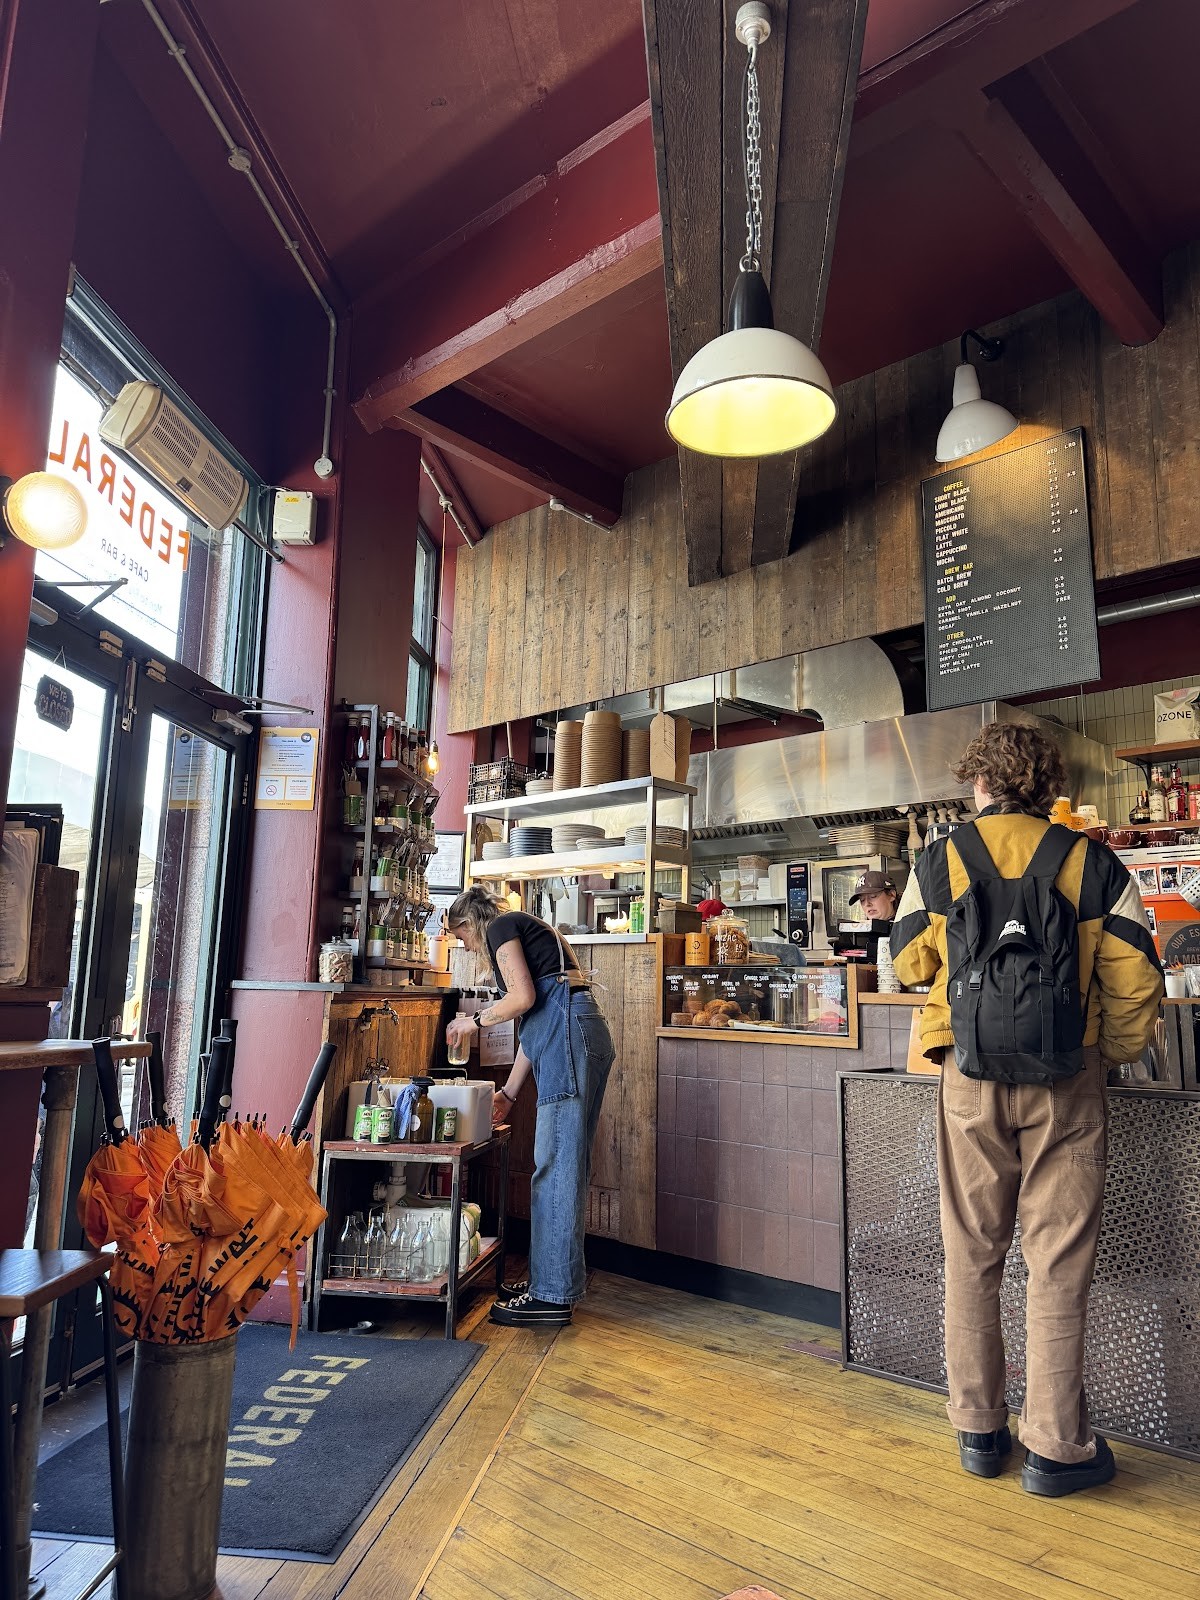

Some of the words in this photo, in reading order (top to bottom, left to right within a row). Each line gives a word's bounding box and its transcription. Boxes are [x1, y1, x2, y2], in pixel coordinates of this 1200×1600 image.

[943, 480, 964, 492] COFFEE
[934, 492, 951, 503] SHORT
[953, 486, 970, 497] BLACK
[935, 501, 949, 511] LONG
[950, 496, 967, 506] BLACK
[935, 505, 965, 519] AMERICANO
[935, 512, 965, 527] MACCHIATO
[935, 523, 957, 535] PICCOLO
[935, 533, 949, 542] FLAT
[951, 527, 968, 538] WHITE
[936, 540, 953, 551] LATTE
[936, 544, 968, 558] CAPPUCCINO
[936, 556, 955, 566] MOCHA
[944, 565, 960, 576] BREW
[963, 562, 974, 571] BAR
[937, 576, 954, 586] BATCH
[956, 571, 972, 580] BREW
[937, 584, 951, 594] COLD
[953, 580, 969, 590] BREW
[938, 604, 952, 612] SOYA
[970, 594, 992, 603] ALMOND
[995, 586, 1021, 597] COCONUT
[945, 594, 957, 603] ADD
[938, 610, 955, 618] EXTRA
[957, 605, 972, 613] SHOT
[938, 615, 962, 624] CARAMEL
[966, 608, 989, 618] VANILLA
[993, 600, 1022, 611] HAZELNUT
[938, 623, 955, 631] DECAF
[1056, 595, 1071, 603] FREE
[946, 631, 965, 641] OTHER
[952, 635, 983, 646] CHOCOLATE
[975, 640, 994, 648] LATTE
[939, 667, 961, 675] MATCHA
[963, 663, 981, 671] LATTE
[1157, 711, 1192, 723] OZONE
[714, 934, 737, 942] ANZAC
[1171, 933, 1187, 949] OUR
[1168, 954, 1179, 965] LA
